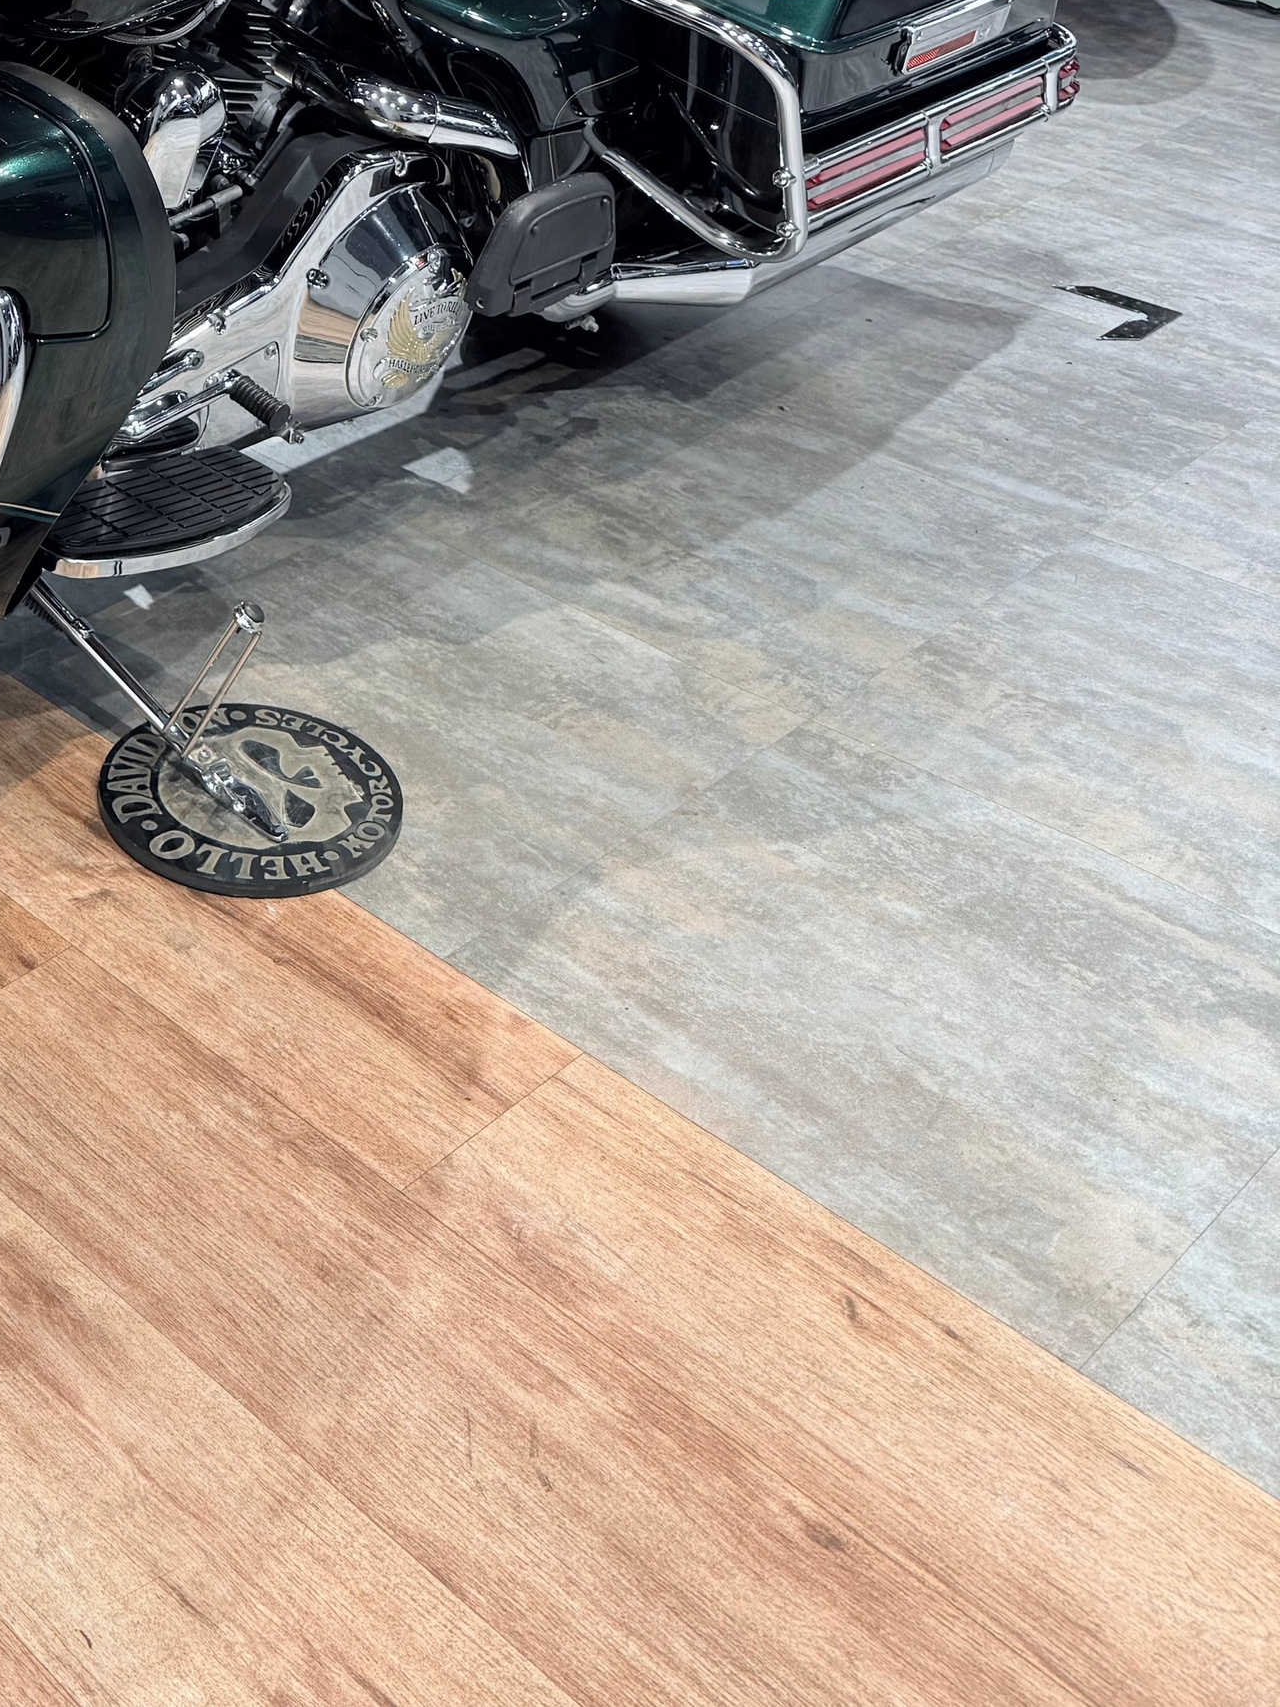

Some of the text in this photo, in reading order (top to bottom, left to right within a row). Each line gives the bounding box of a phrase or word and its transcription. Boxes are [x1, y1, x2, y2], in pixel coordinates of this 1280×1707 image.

[414, 305, 435, 325] LIVE
[107, 707, 330, 880] HELLO DAVIDON
[254, 708, 395, 859] MOTORCYCLES
